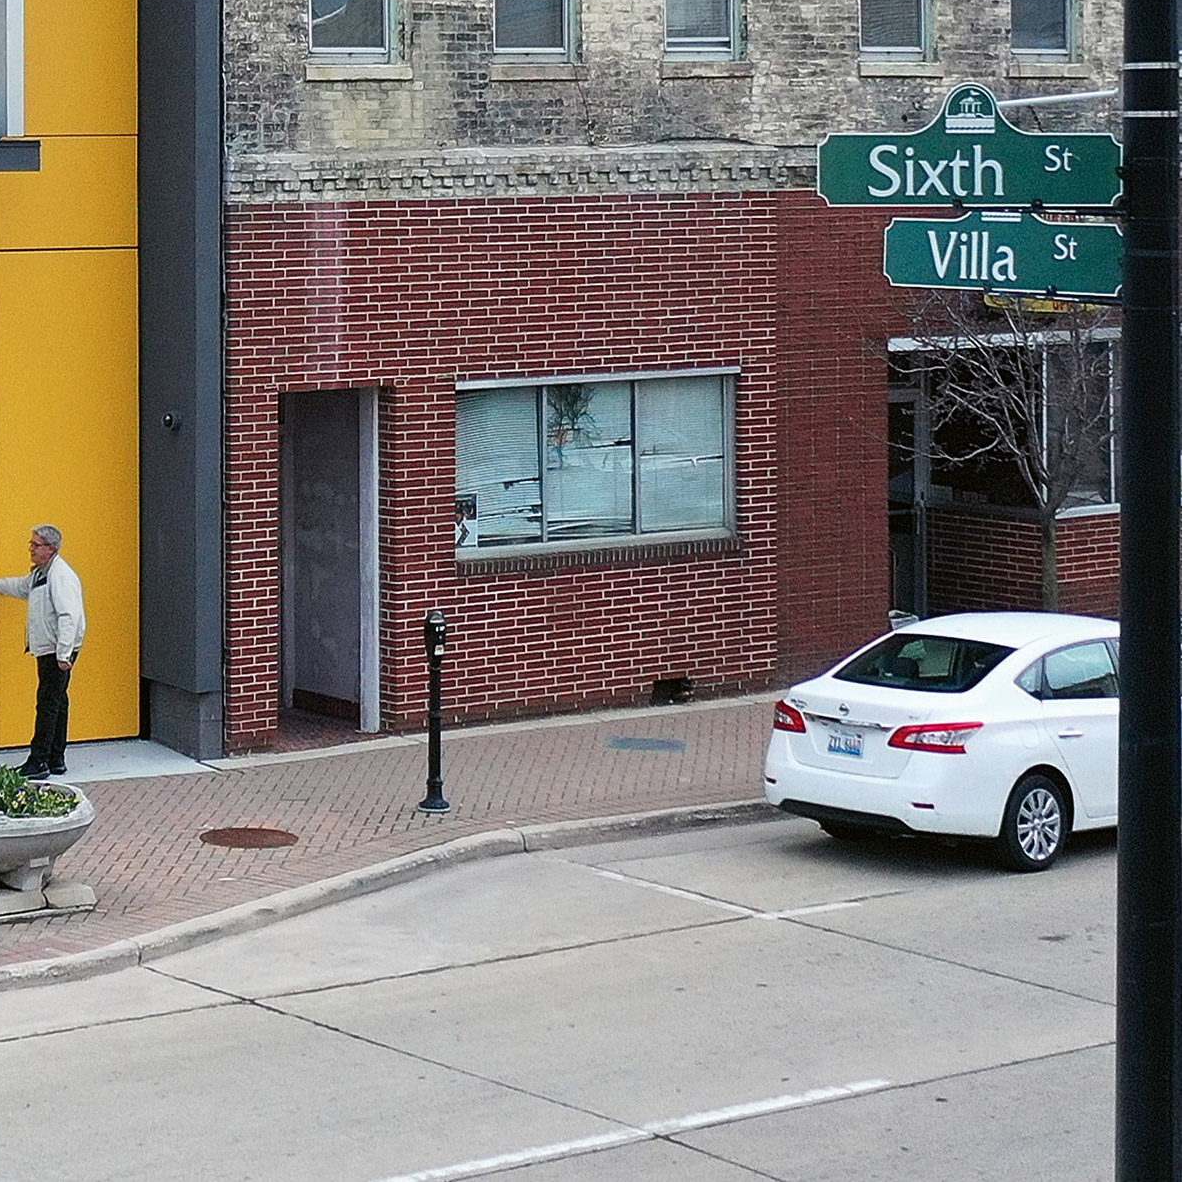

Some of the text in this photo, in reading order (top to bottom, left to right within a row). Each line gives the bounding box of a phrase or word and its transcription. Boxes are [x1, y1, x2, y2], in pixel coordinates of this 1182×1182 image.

[868, 144, 1073, 197] Sixth St
[927, 230, 1079, 282] Villa St
